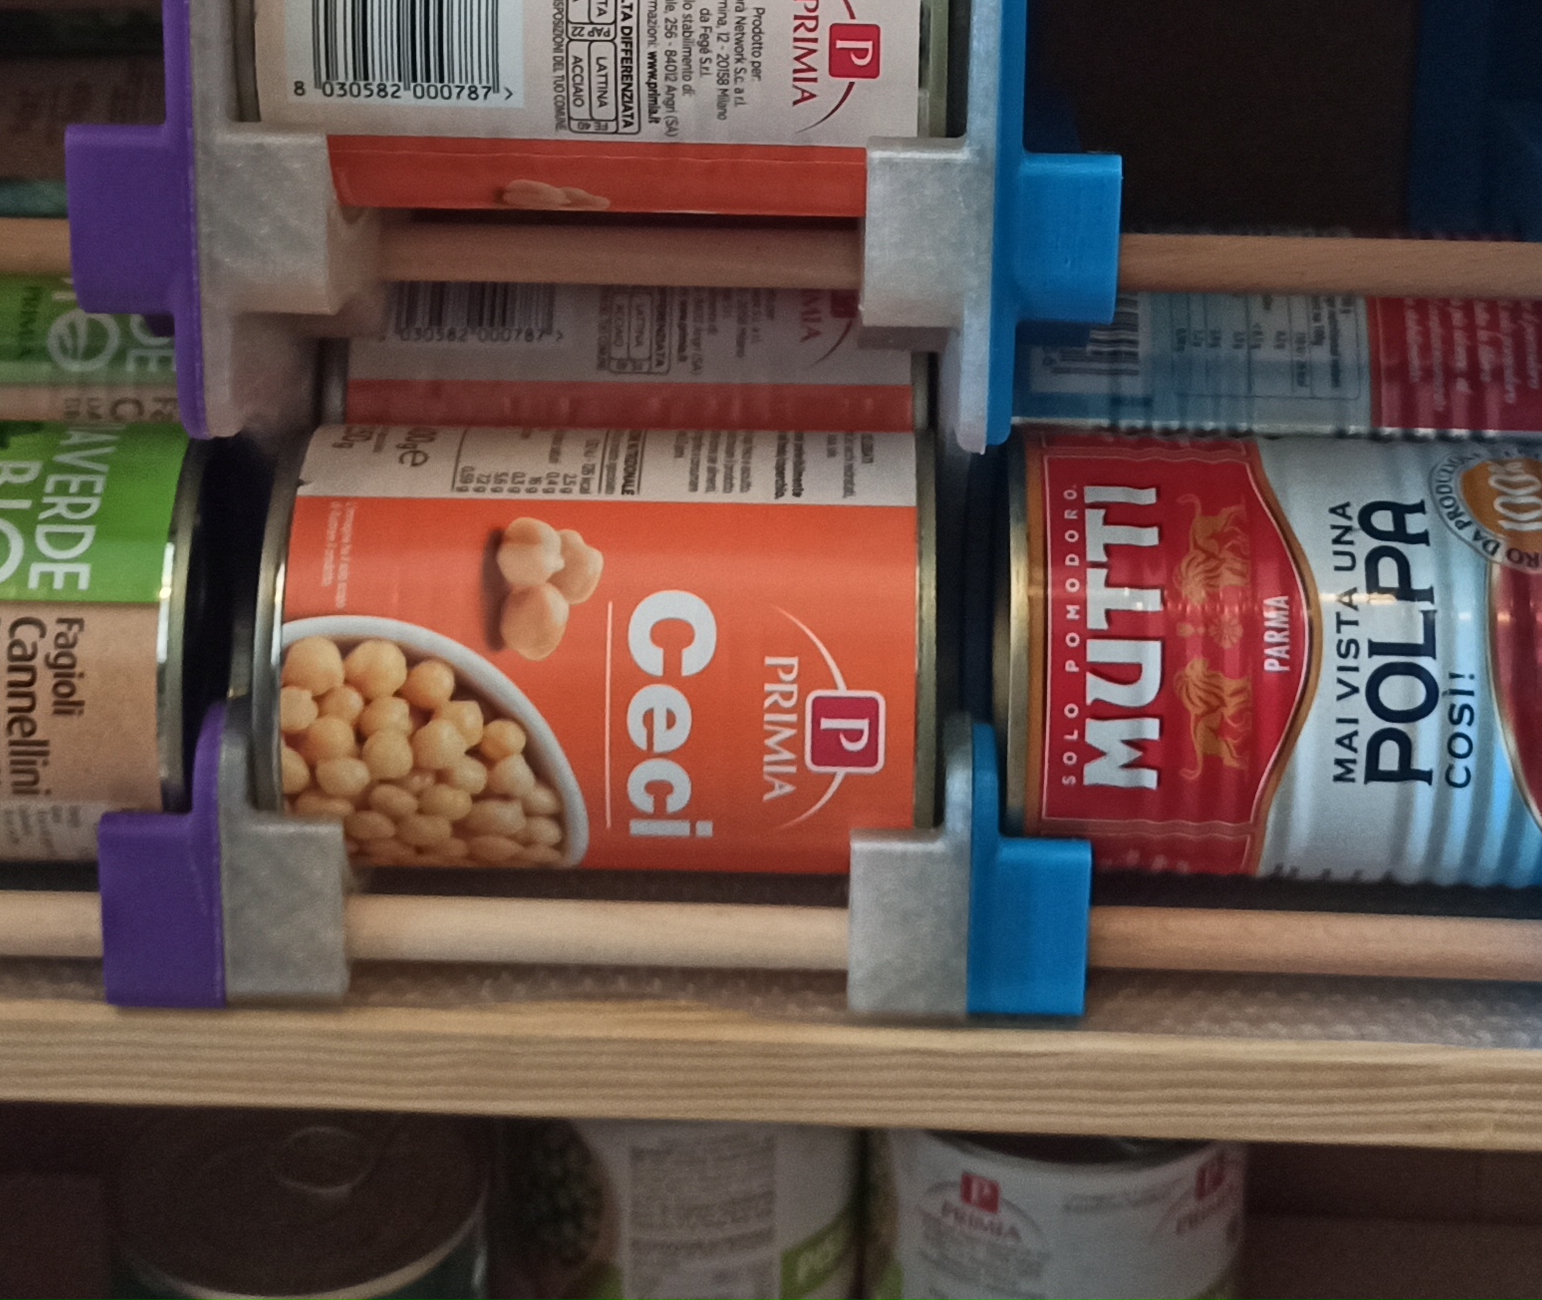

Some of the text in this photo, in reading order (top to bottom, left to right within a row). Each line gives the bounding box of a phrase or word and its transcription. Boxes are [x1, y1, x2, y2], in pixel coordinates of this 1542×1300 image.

[571, 26, 610, 37] PAP 22
[665, 17, 677, 38] 256
[700, 8, 712, 23] da
[717, 32, 729, 43] 12
[734, 16, 746, 64] Network
[751, 7, 765, 58] Prodotto
[553, 55, 565, 73] DEL
[664, 50, 677, 81] 84012
[682, 14, 694, 81] stabilimento
[717, 54, 729, 85] 20158
[294, 80, 492, 101] 8 030582 000787
[554, 75, 565, 93] TUO
[572, 55, 584, 107] ACCIAIO
[596, 57, 608, 108] LATTINA
[621, 26, 634, 128] DIFFERENZIATA
[646, 51, 660, 124] www.primia.it
[663, 85, 677, 113] Angri
[554, 94, 566, 131] COMUNE
[664, 116, 678, 137] (SA)
[717, 88, 729, 120] Milano
[1472, 530, 1501, 556] DA
[1083, 485, 1163, 790] MUTTI
[1263, 595, 1291, 672] PARMA
[1328, 501, 1359, 784] MAI VISTA UNA
[1357, 499, 1439, 786] POLPA
[45, 617, 85, 717] Fagioli
[6, 617, 52, 796] Cannellini
[626, 588, 718, 838] Ceci
[762, 656, 799, 802] PRIMIA
[1442, 672, 1475, 788] COSÌ!
[1061, 703, 1080, 786] SOLO
